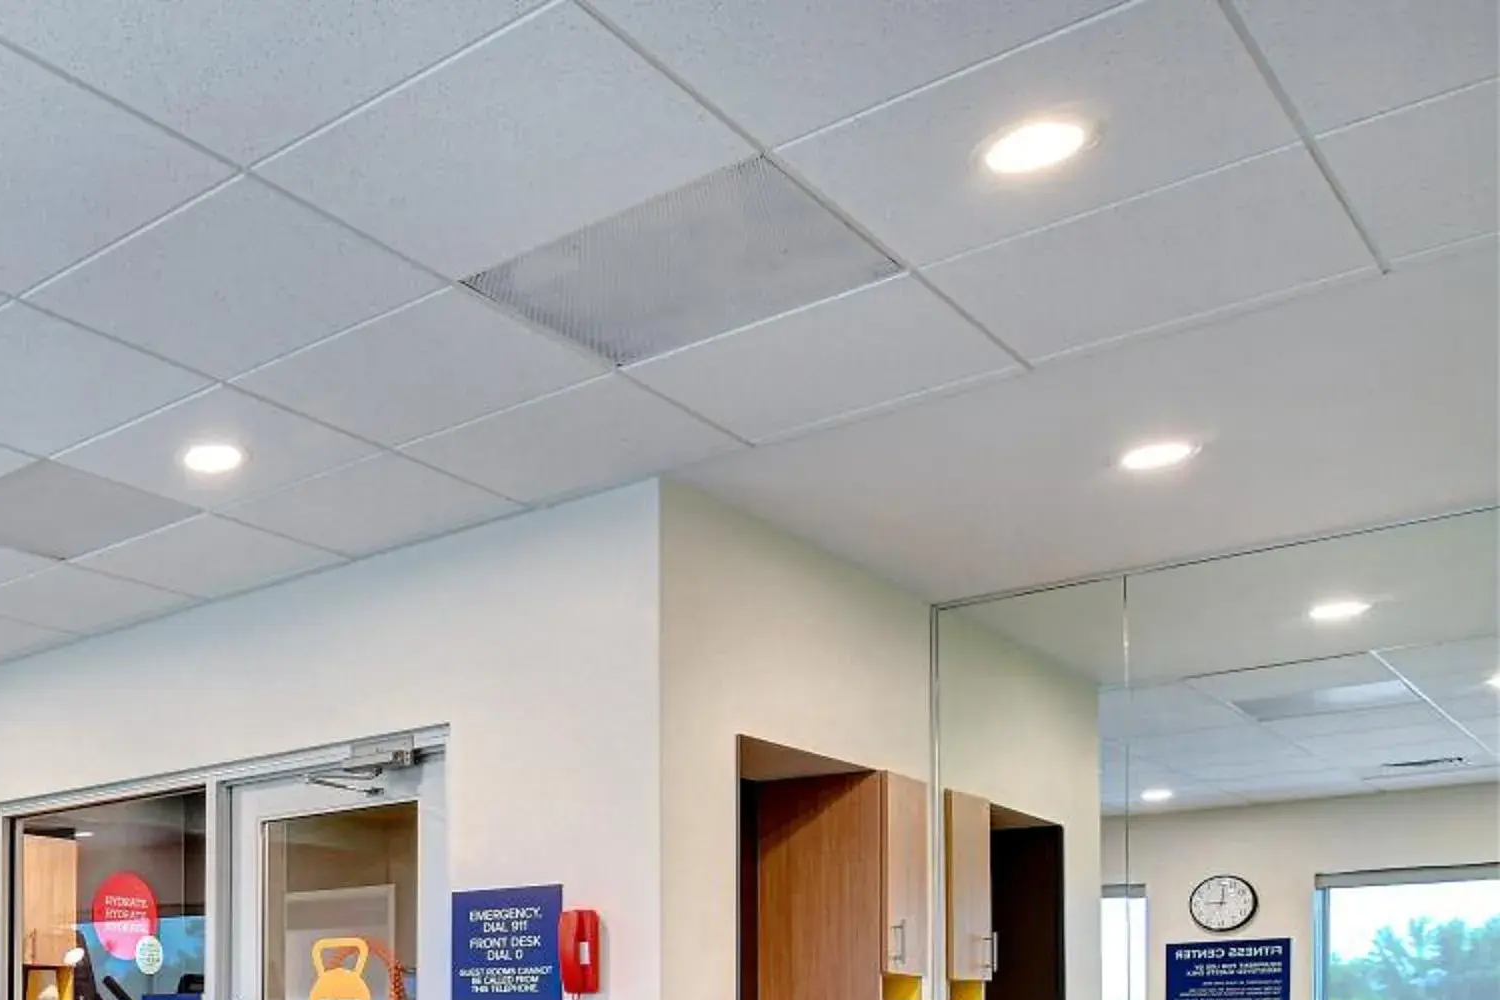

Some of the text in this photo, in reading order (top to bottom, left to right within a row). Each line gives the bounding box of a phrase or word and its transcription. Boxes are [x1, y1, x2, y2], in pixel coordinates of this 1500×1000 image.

[483, 920, 527, 933] DIAL 911
[469, 935, 541, 949] FRONT DESK
[487, 949, 512, 960] DIAL
